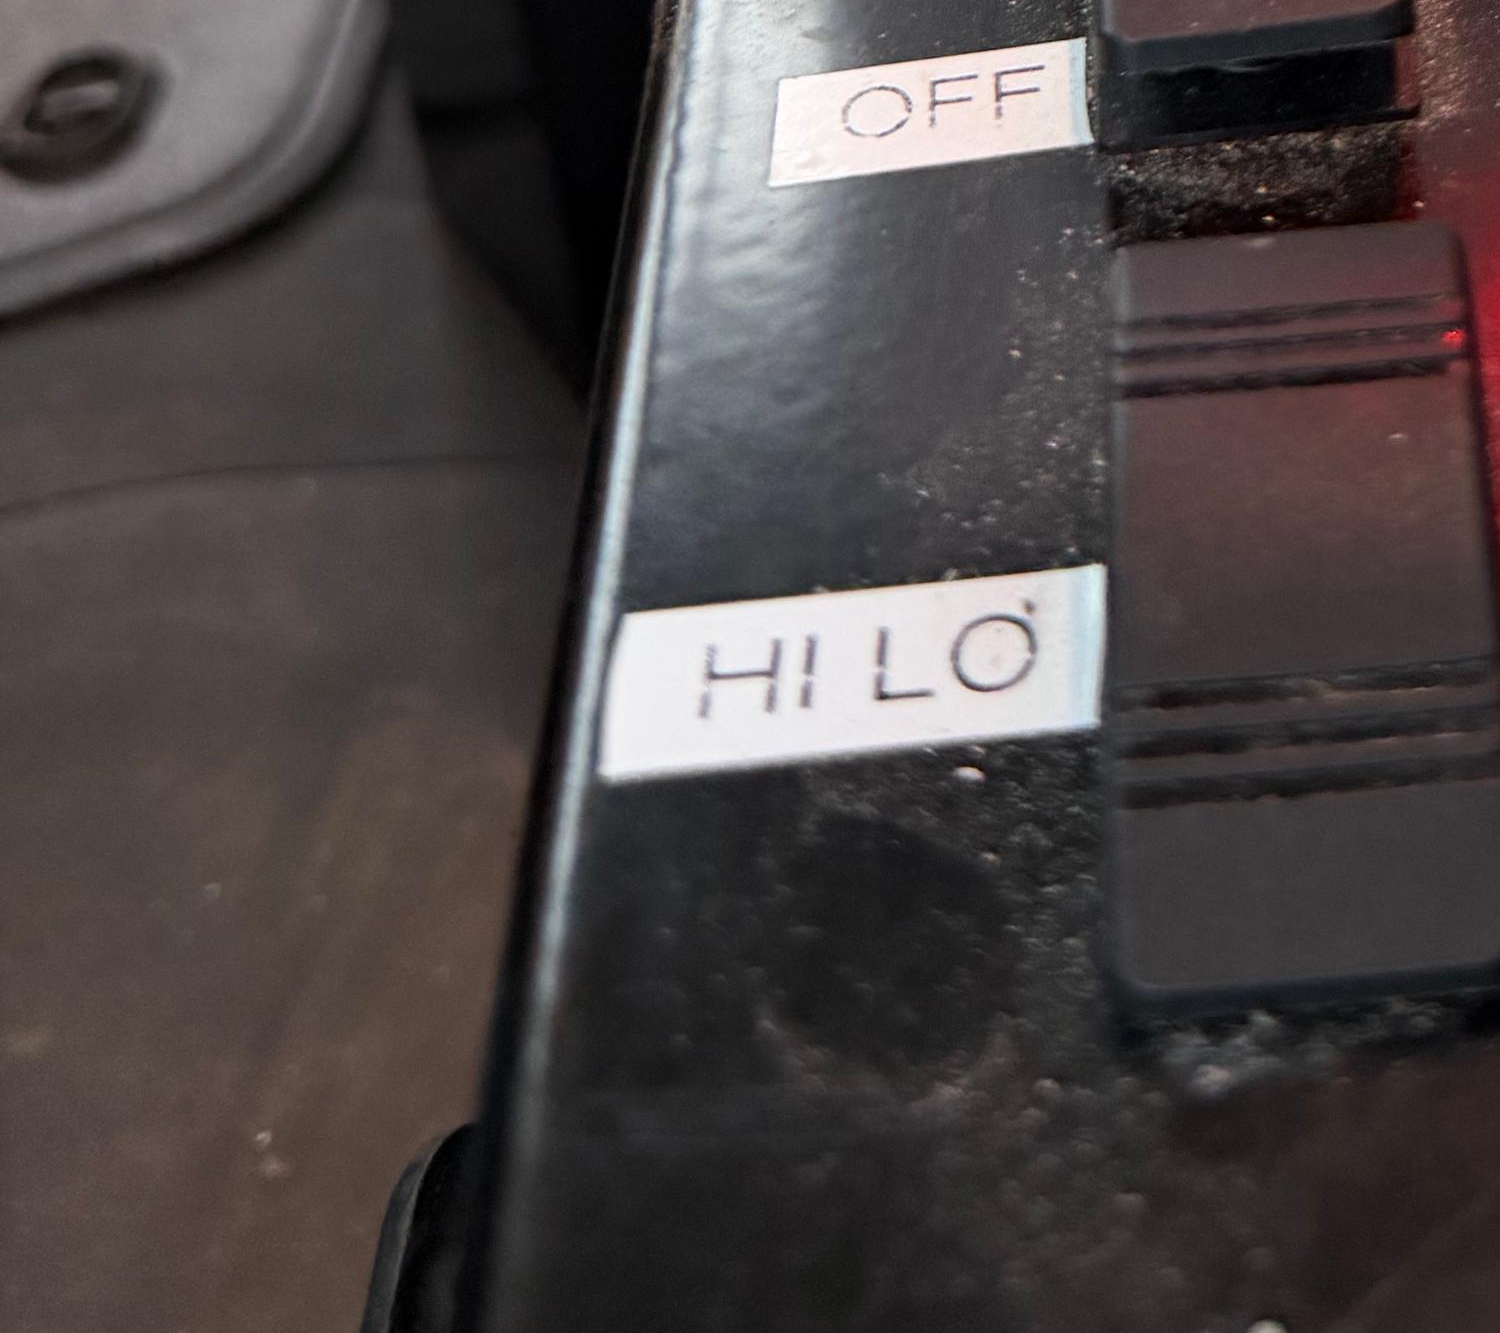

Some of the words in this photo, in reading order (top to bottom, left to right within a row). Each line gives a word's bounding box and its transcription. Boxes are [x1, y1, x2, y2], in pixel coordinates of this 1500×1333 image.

[841, 63, 1045, 138] OFF
[697, 635, 818, 720] HI
[873, 613, 1038, 701] LO
